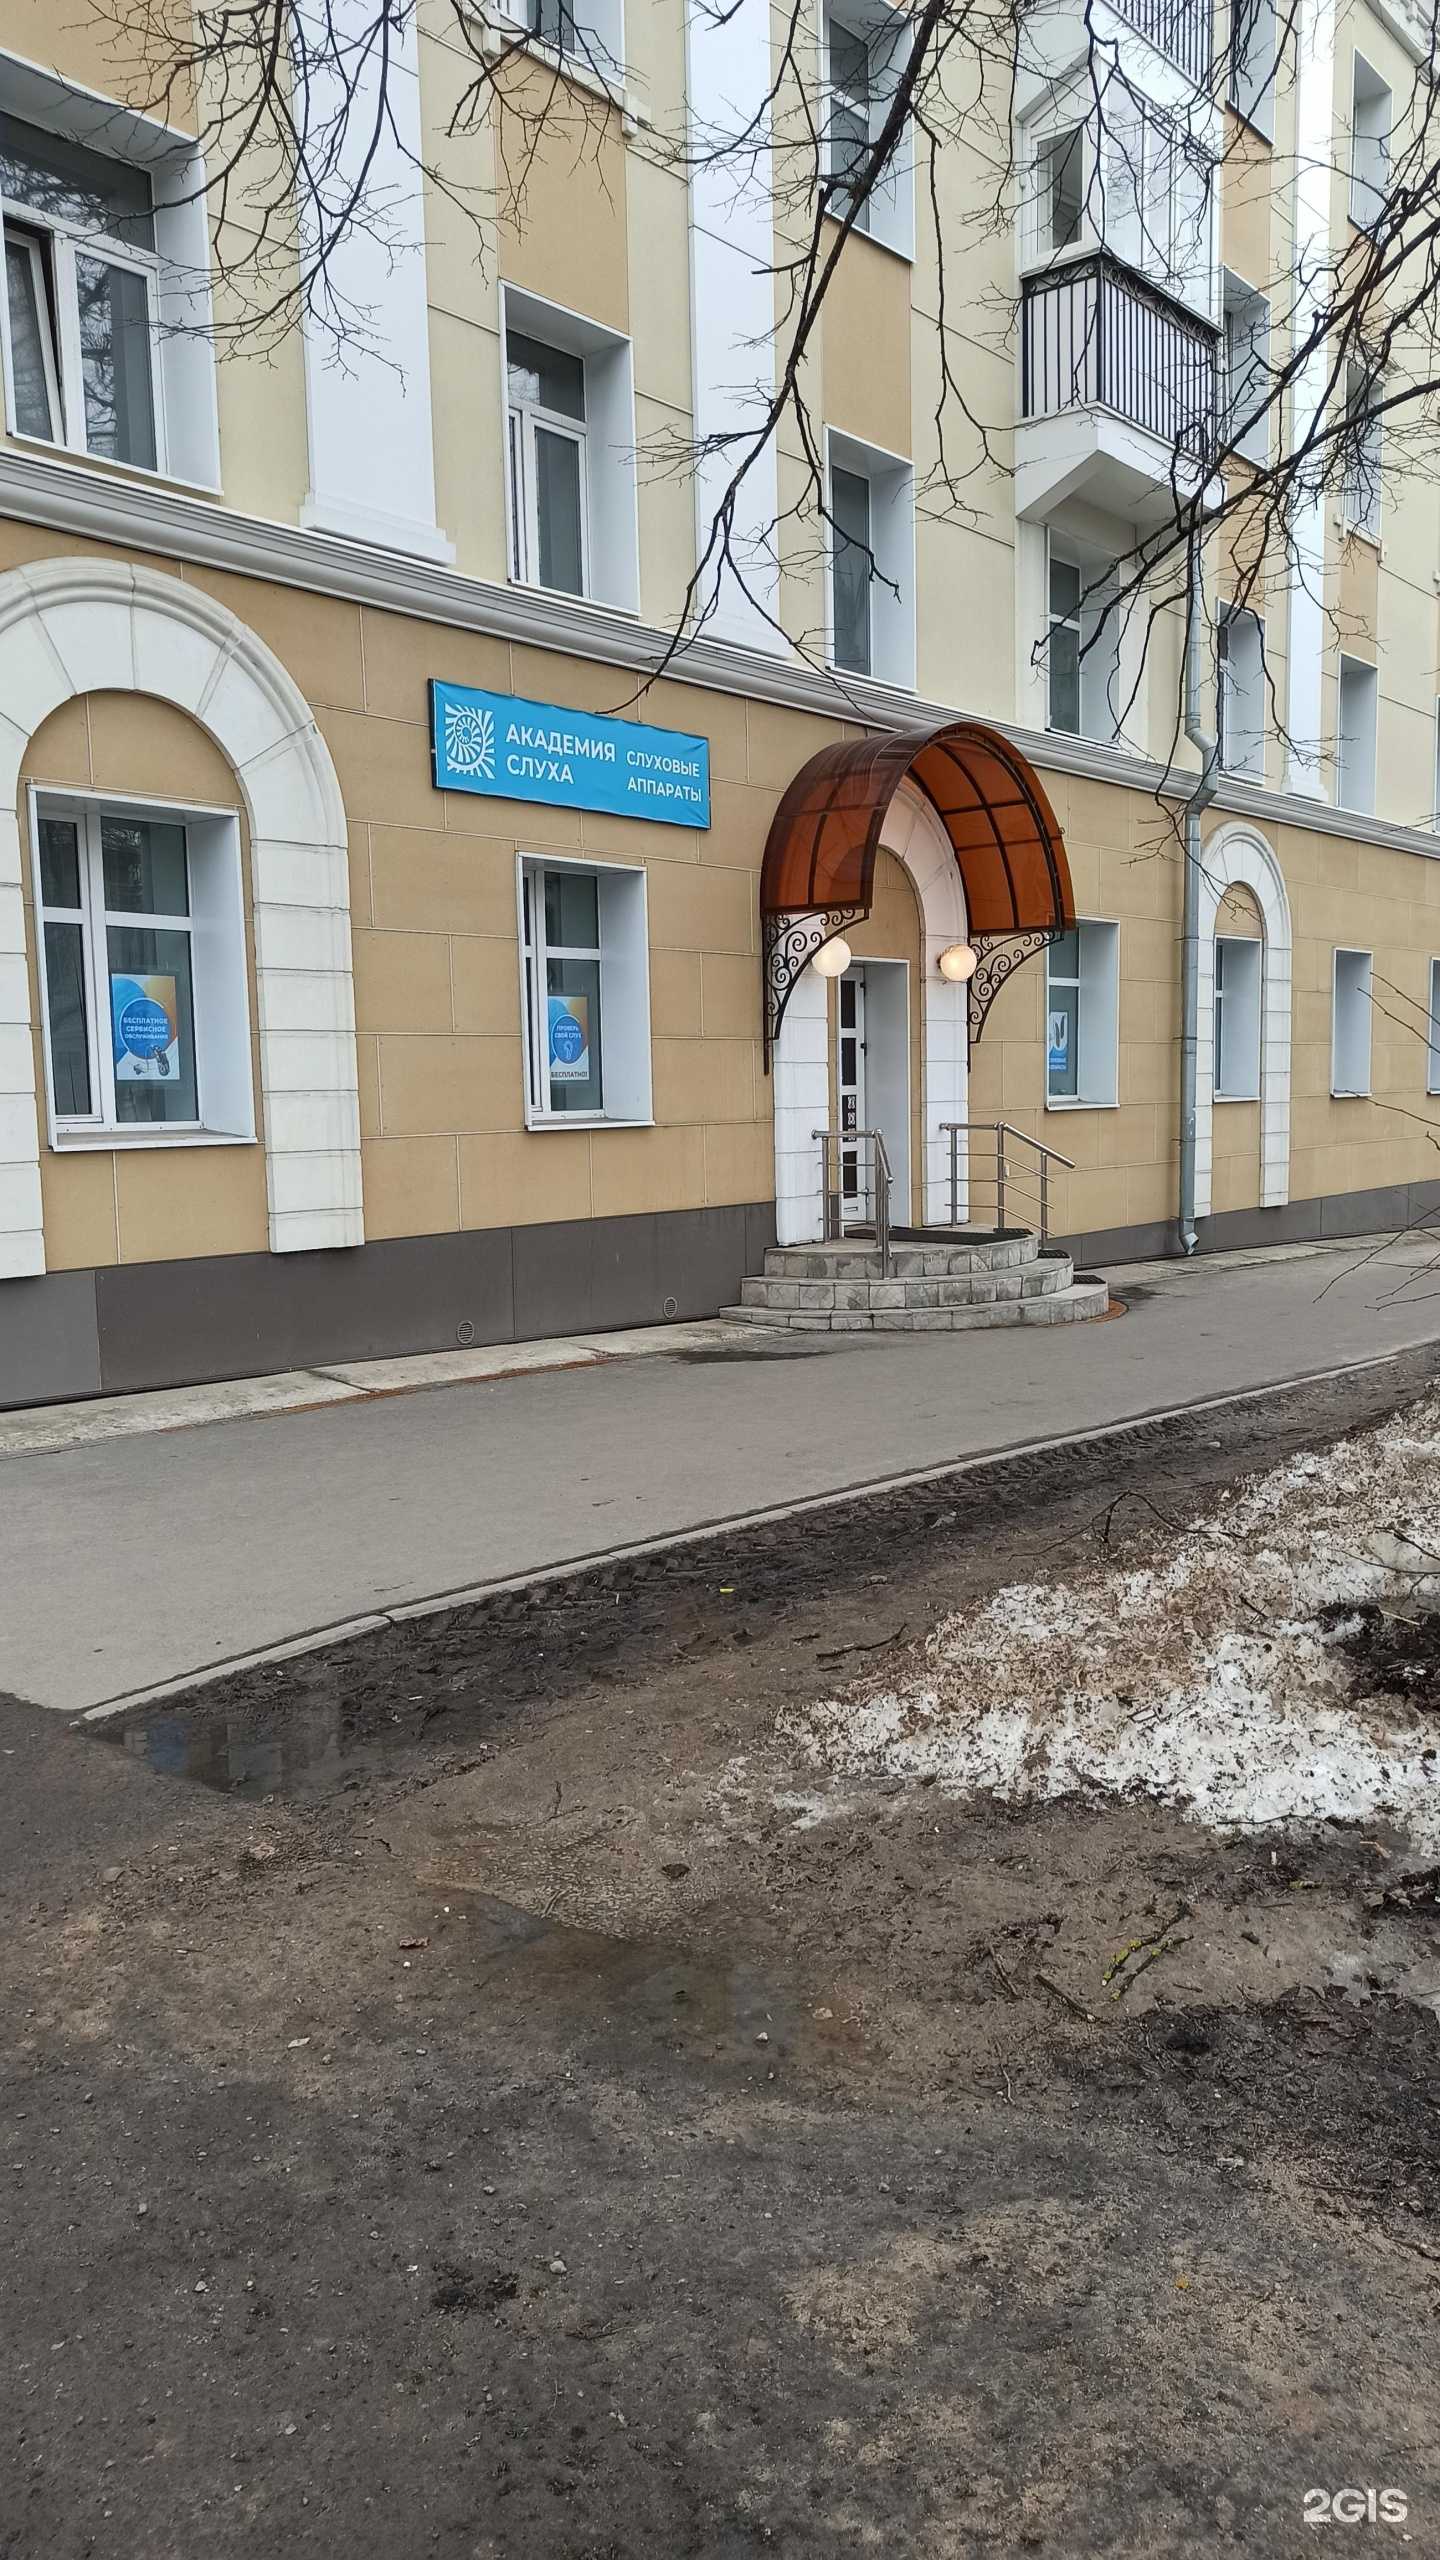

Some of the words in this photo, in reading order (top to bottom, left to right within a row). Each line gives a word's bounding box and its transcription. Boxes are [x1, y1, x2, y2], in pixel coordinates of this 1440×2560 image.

[506, 723, 615, 762] АКАДЕМИЯ
[506, 754, 575, 785] СЛУХА
[626, 750, 700, 777] СЛУХОВЫЕ
[627, 777, 702, 802] АППАРАТЫ
